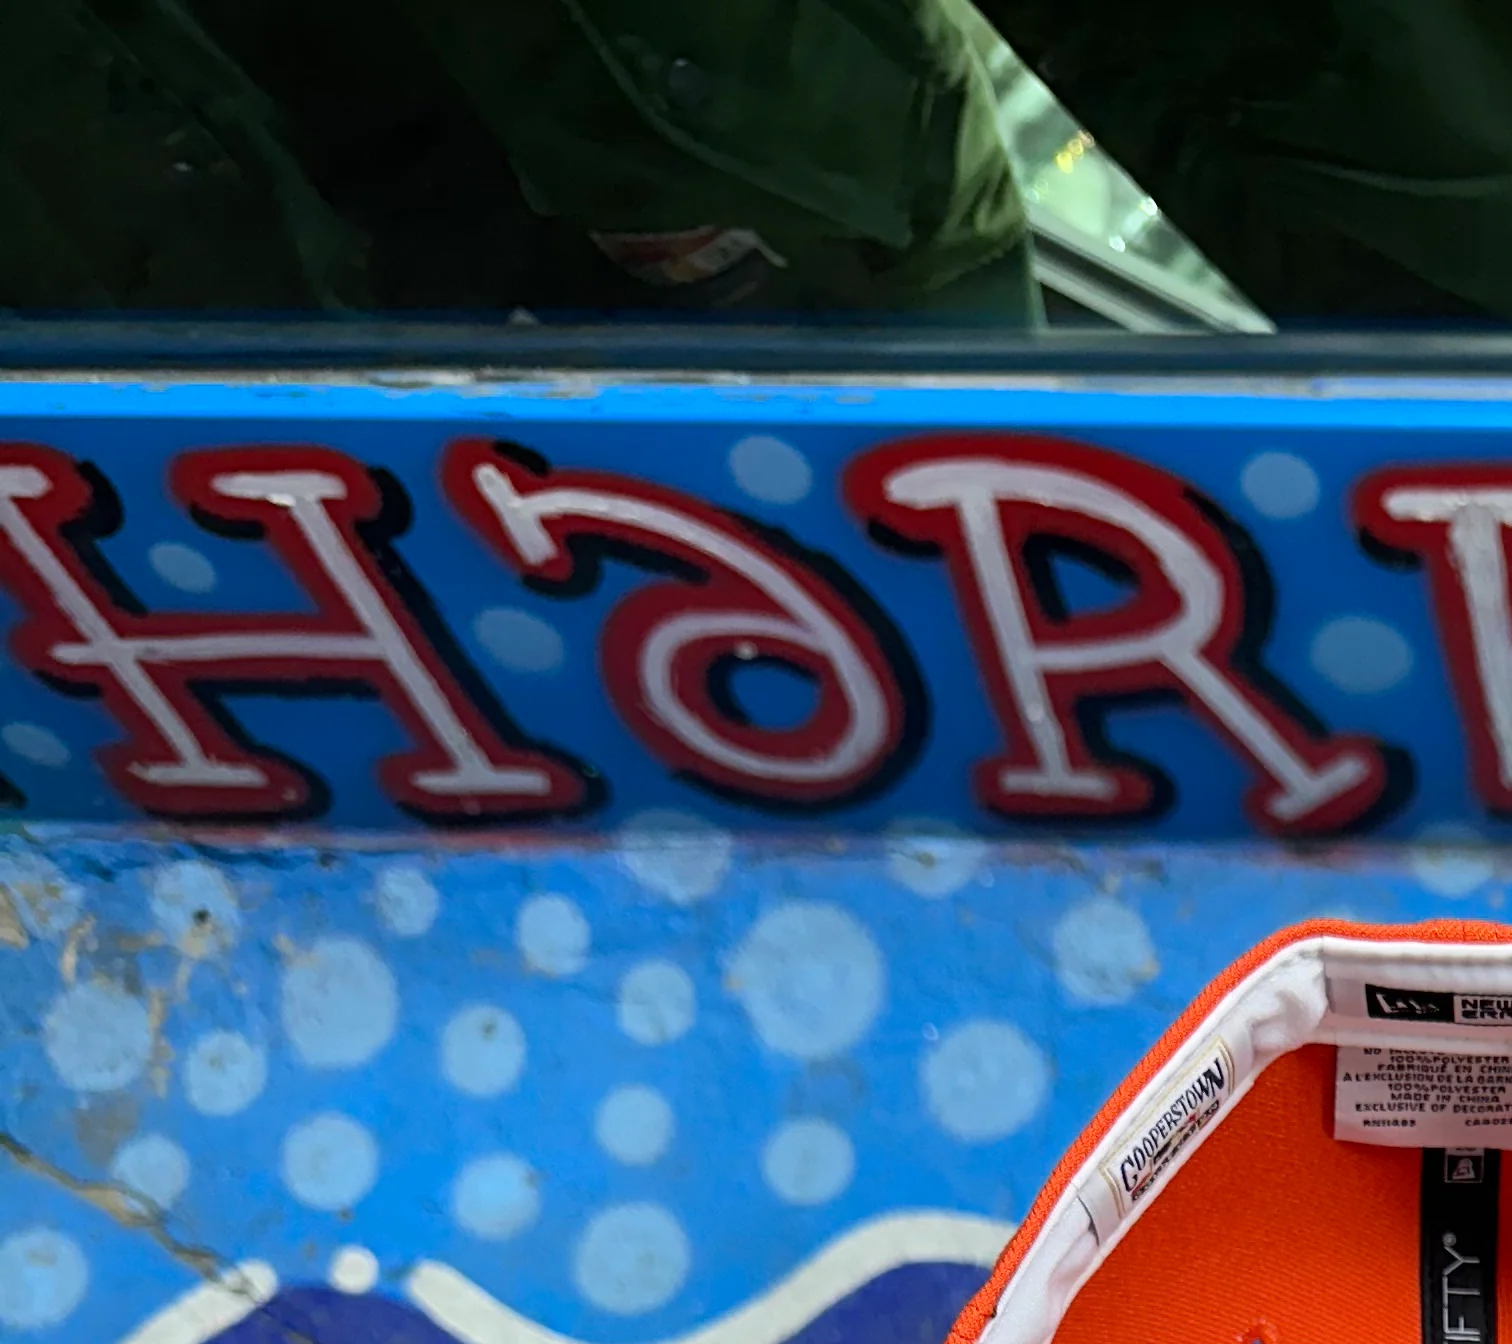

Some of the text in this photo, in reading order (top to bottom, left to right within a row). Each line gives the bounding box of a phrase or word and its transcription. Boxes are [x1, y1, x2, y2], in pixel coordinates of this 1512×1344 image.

[1455, 1065, 1472, 1073] EN
[1391, 1093, 1500, 1103] MADE IN CHINA
[1355, 1102, 1426, 1112] EXCLUSIVE
[1431, 1103, 1447, 1112] OF
[1120, 1057, 1225, 1192] COOPERSTOWN
